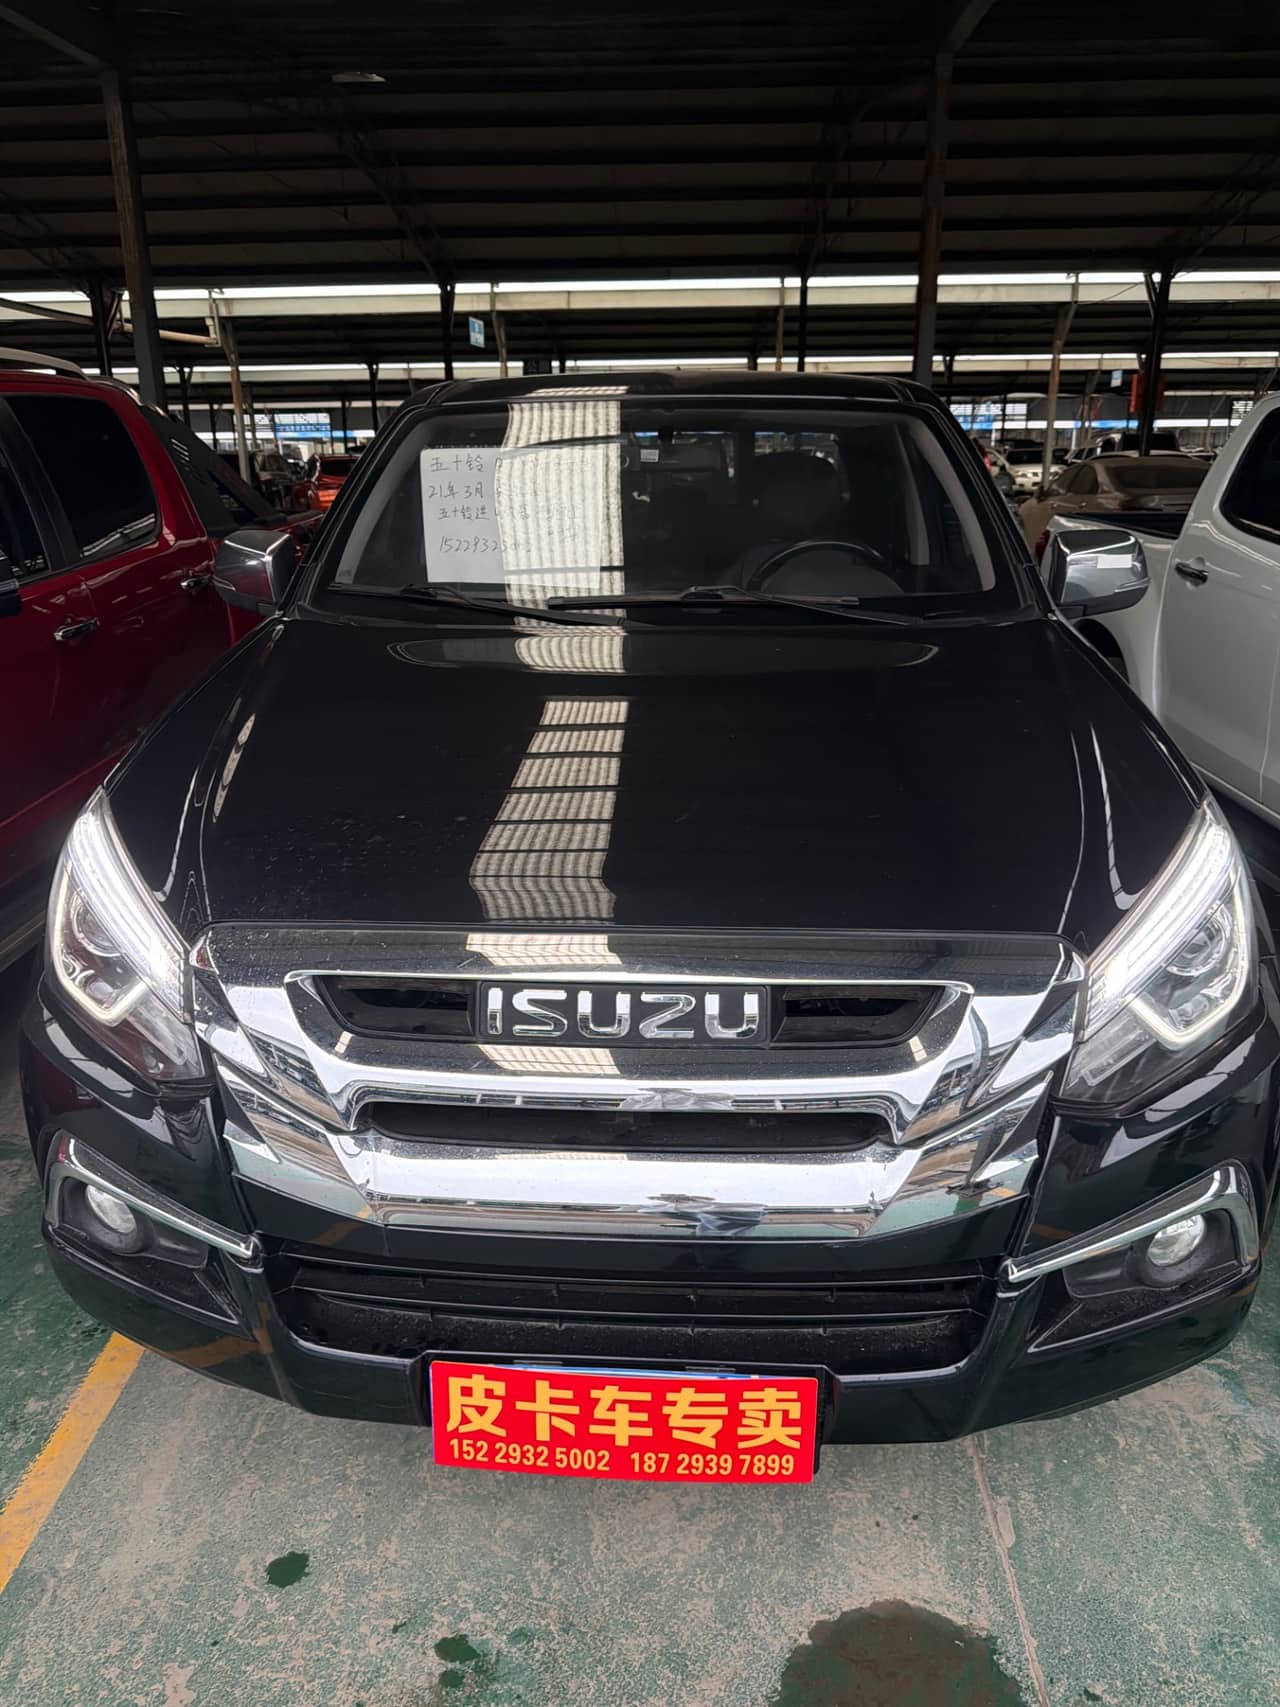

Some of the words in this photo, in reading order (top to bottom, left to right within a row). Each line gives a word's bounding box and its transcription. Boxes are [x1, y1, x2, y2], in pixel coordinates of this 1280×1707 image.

[488, 987, 760, 1039] ISUZU
[446, 1374, 802, 1449] 皮卡车专卖
[450, 1438, 489, 1462] 152
[494, 1442, 549, 1468] 2932
[555, 1447, 610, 1471] 5002
[631, 1451, 669, 1474] 187
[676, 1453, 732, 1475] 2939
[739, 1454, 795, 1476] 7899
